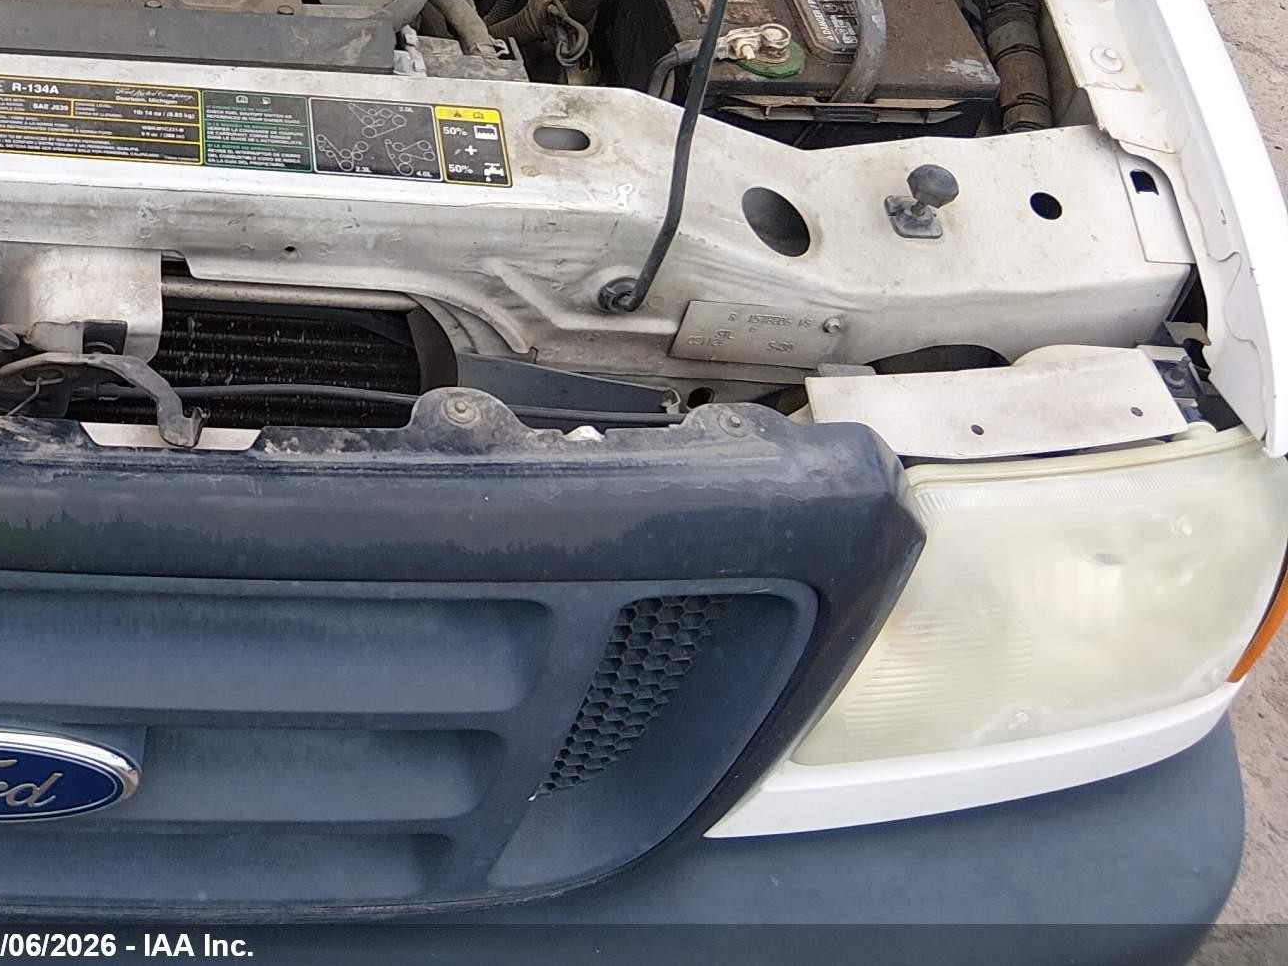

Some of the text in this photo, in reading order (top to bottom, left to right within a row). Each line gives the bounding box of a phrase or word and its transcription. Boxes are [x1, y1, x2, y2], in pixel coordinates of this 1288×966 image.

[12, 82, 59, 94] R-134A
[443, 126, 468, 136] 50%
[448, 164, 474, 174] 50%
